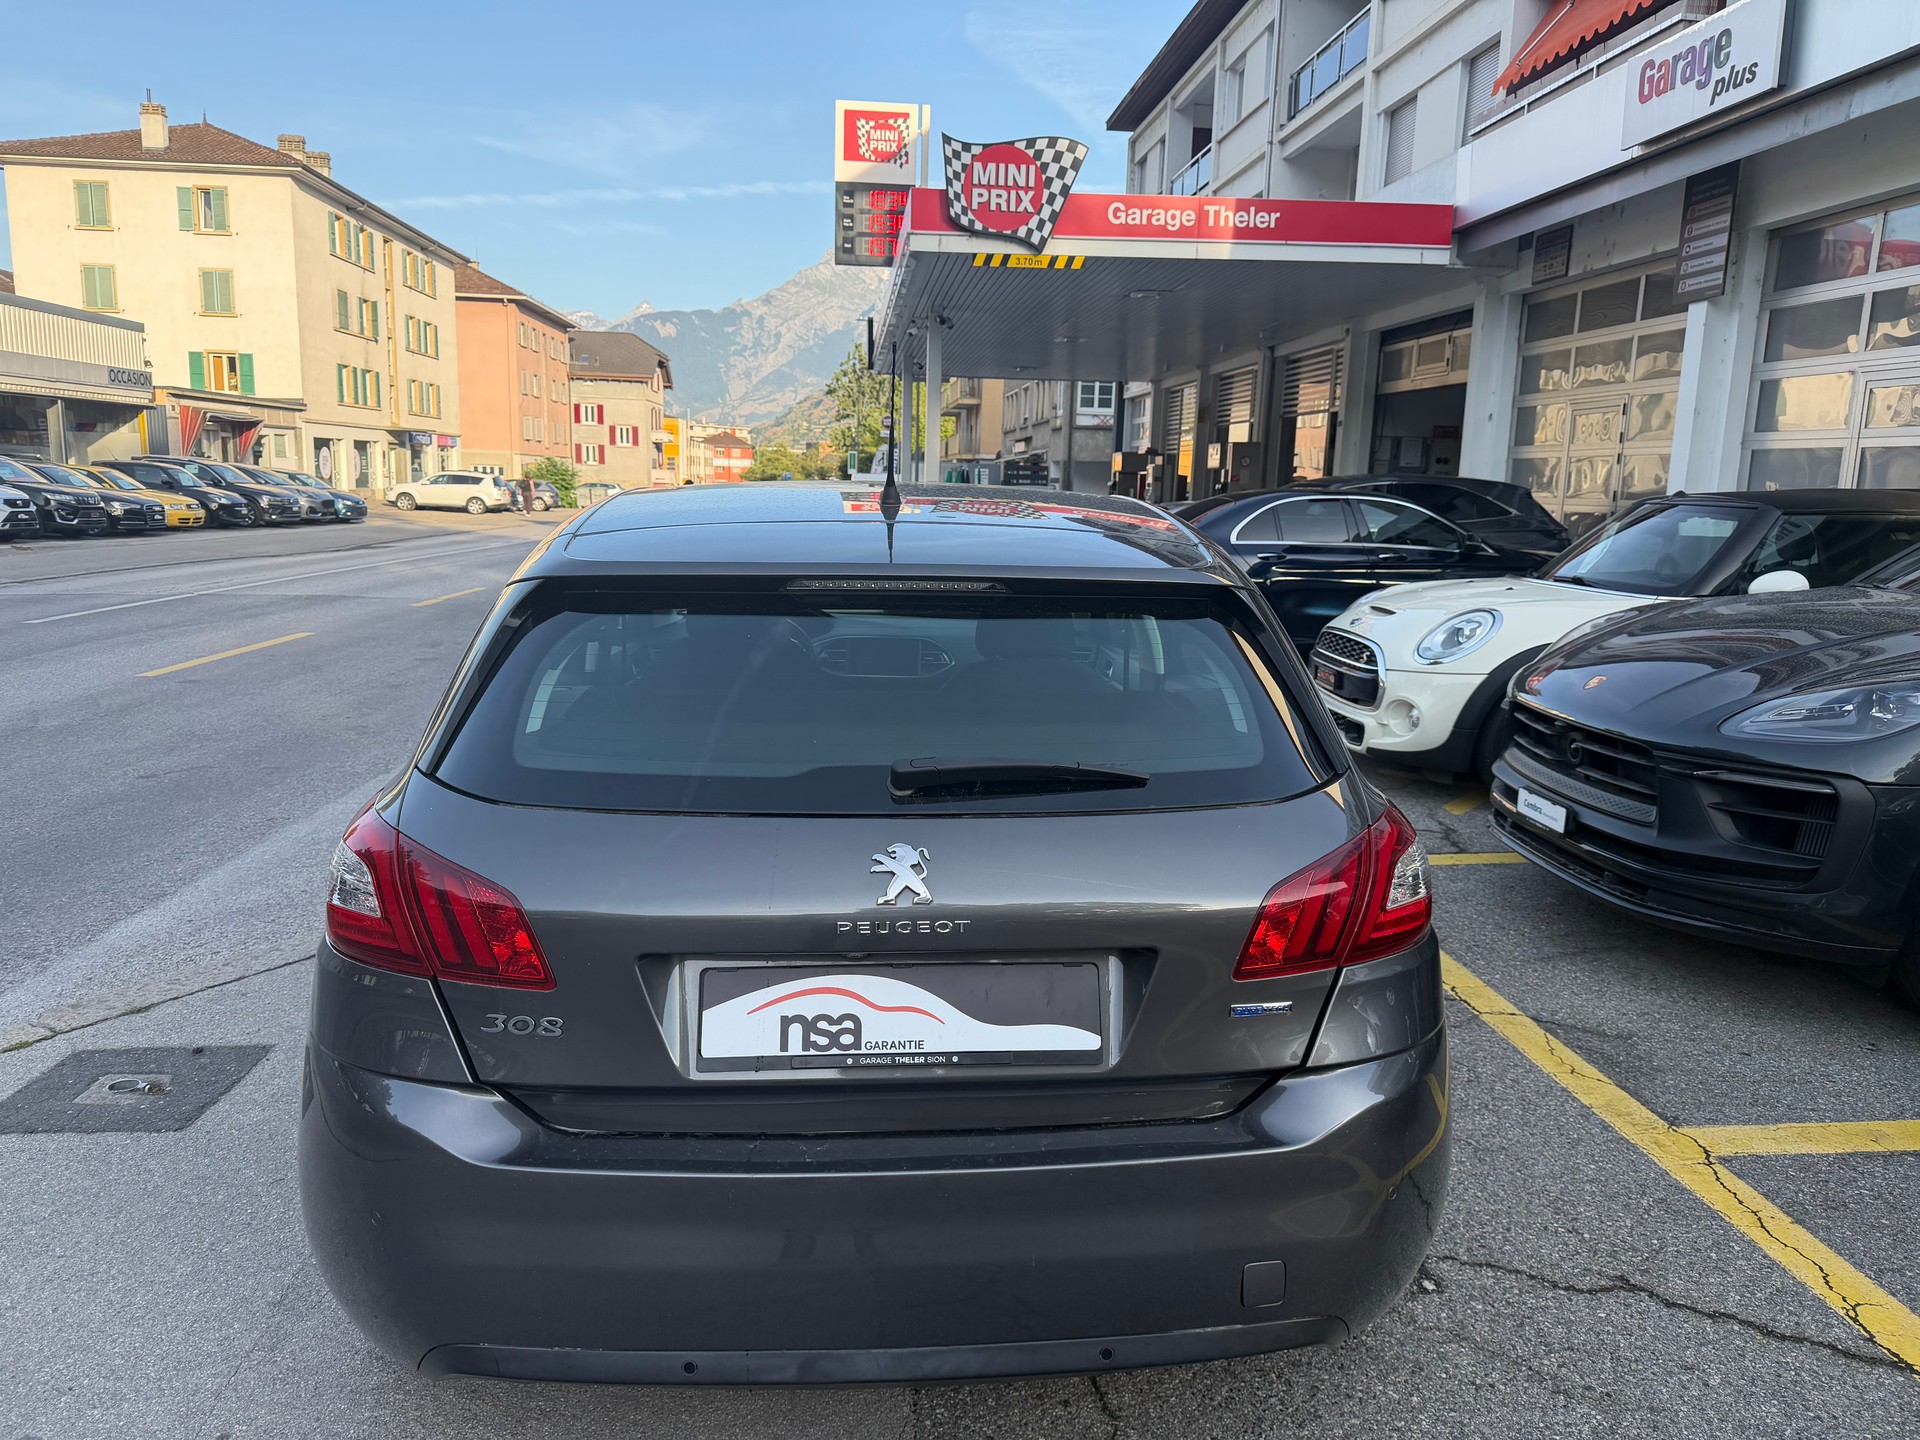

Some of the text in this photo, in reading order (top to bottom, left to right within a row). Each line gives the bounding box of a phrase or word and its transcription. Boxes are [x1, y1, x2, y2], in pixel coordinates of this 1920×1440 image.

[1638, 28, 1732, 104] Garage
[1709, 62, 1758, 106] plus
[870, 128, 899, 141] MINI
[870, 141, 899, 153] PRIX
[971, 162, 1036, 188] MINI
[971, 188, 1035, 213] PRIX
[1107, 201, 1281, 231] Garage Theler
[109, 368, 152, 387] OCCASION
[837, 920, 971, 934] PEUGEOT
[480, 1013, 564, 1037] 308
[780, 1013, 925, 1052] nsa GARANTIE
